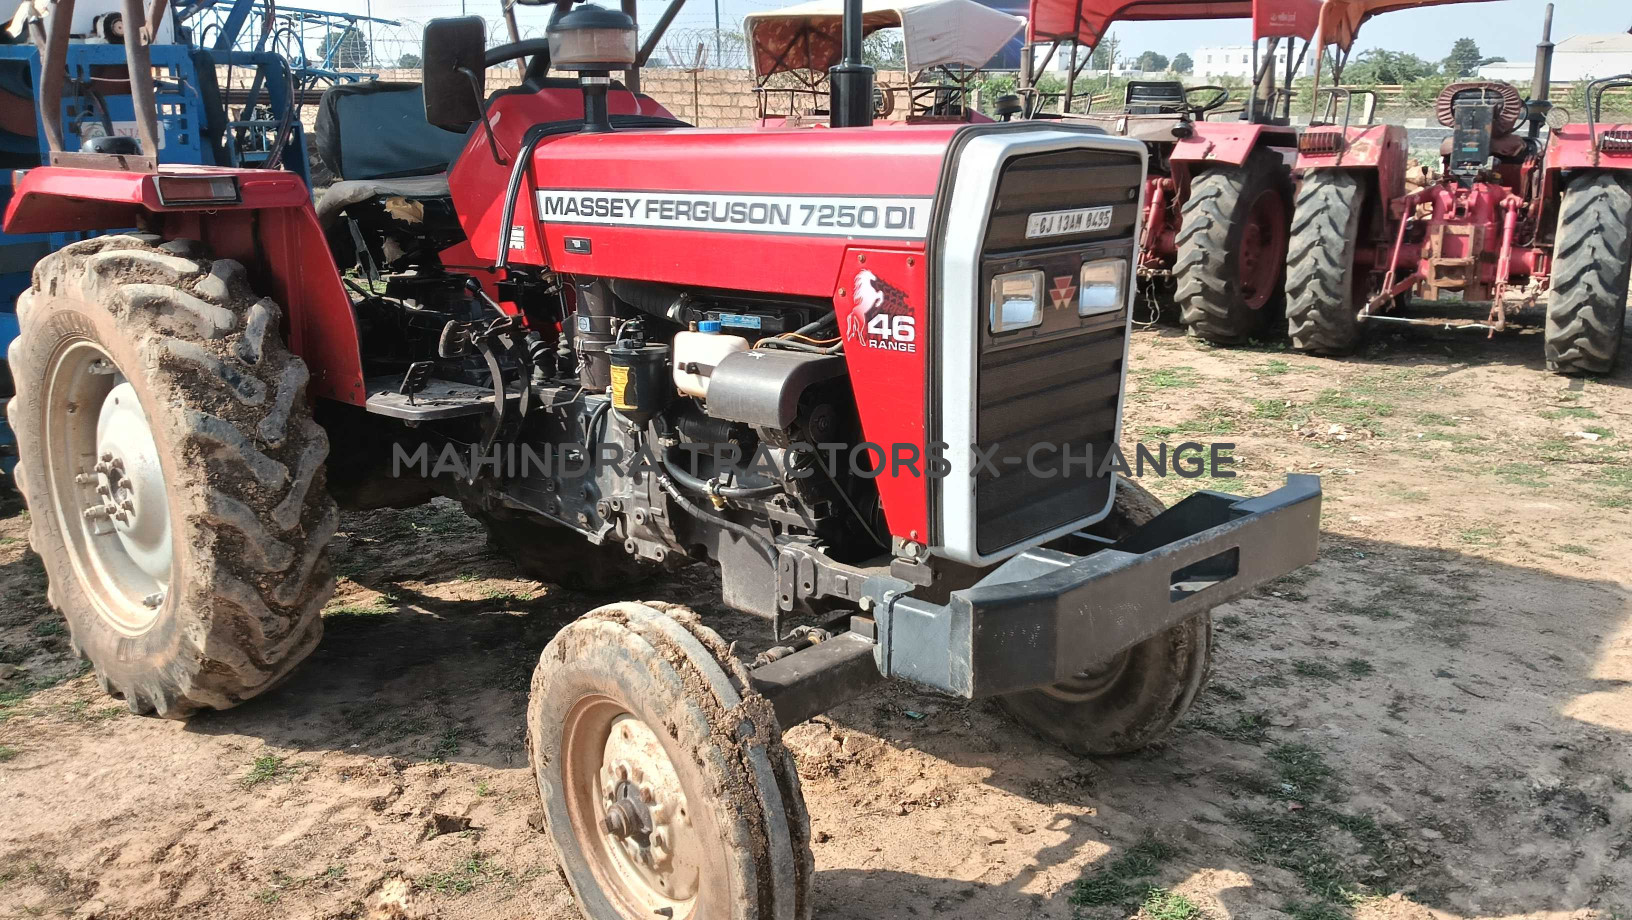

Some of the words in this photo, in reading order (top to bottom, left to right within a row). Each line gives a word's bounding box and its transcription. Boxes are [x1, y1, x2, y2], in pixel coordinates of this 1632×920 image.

[545, 196, 641, 218] MASSEY
[645, 199, 792, 224] FERGUSON
[800, 204, 879, 229] 7250
[884, 206, 916, 230] DI
[1040, 217, 1054, 234] GJ
[867, 313, 916, 342] 46
[868, 339, 916, 353] RANGE
